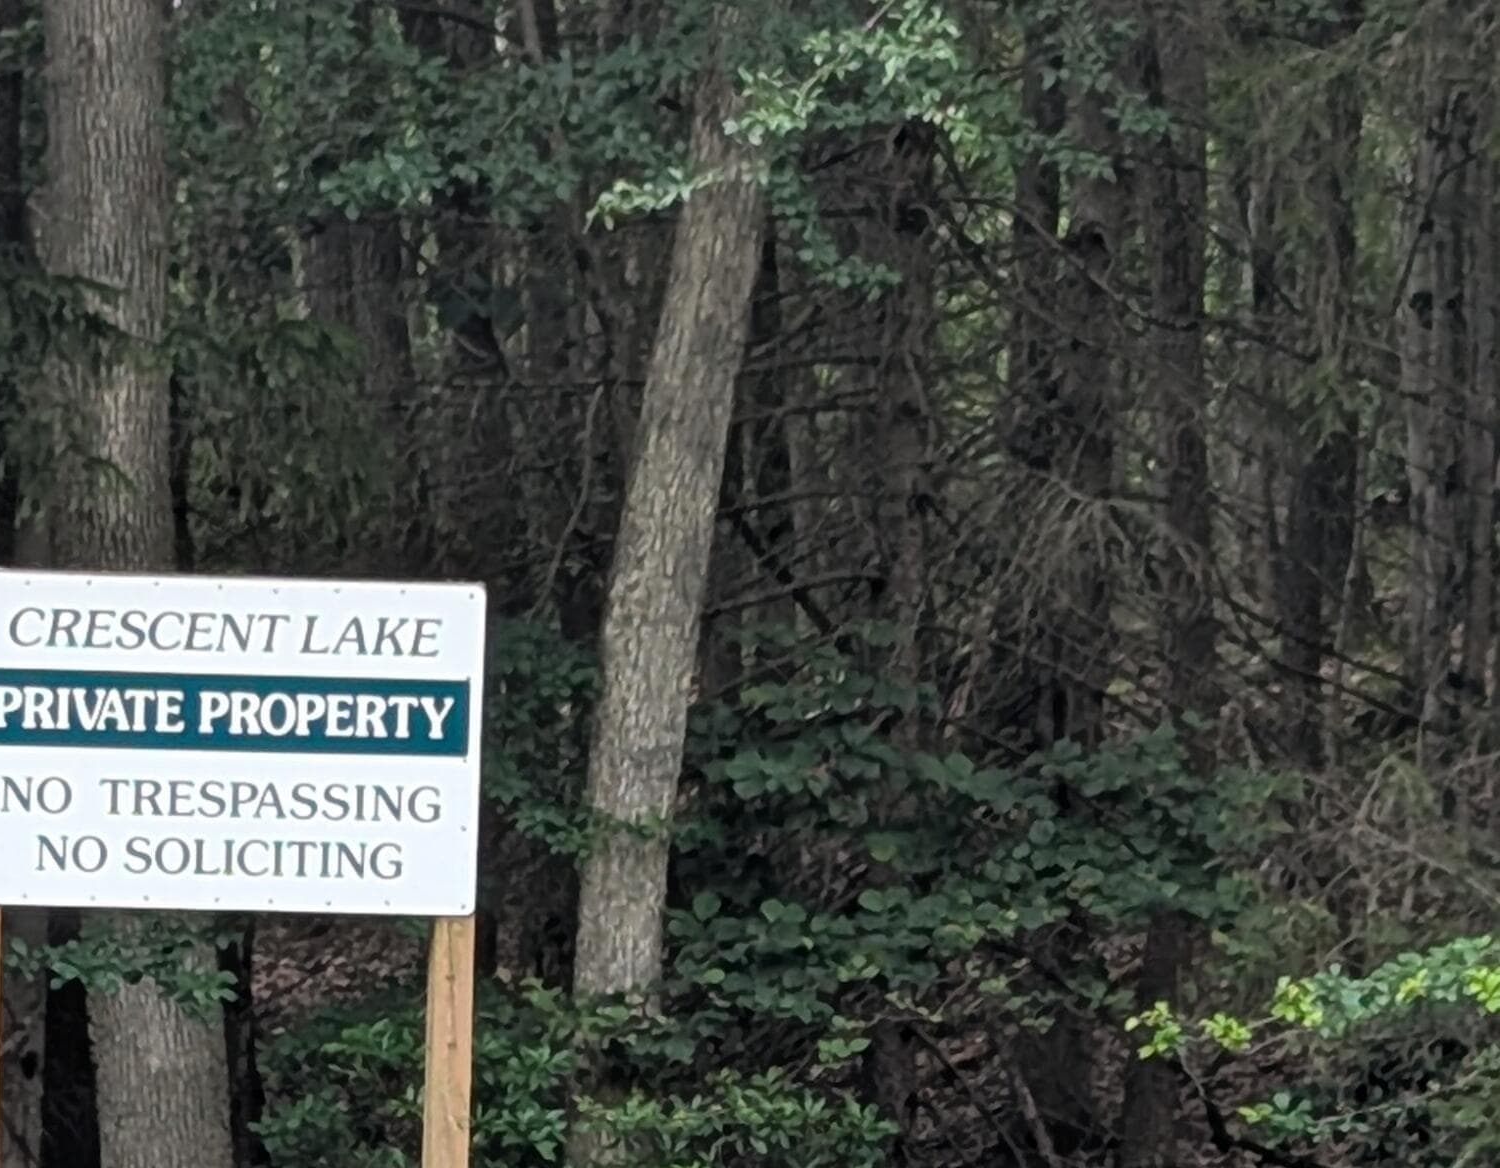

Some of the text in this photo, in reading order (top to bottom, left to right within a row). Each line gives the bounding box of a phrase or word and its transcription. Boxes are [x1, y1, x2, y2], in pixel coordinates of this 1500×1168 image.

[9, 607, 443, 657] CRESCENT LAKE
[198, 691, 455, 739] PROPERTY
[0, 776, 442, 823] NO TRESPASSING
[37, 835, 404, 880] NO SOLICITING
